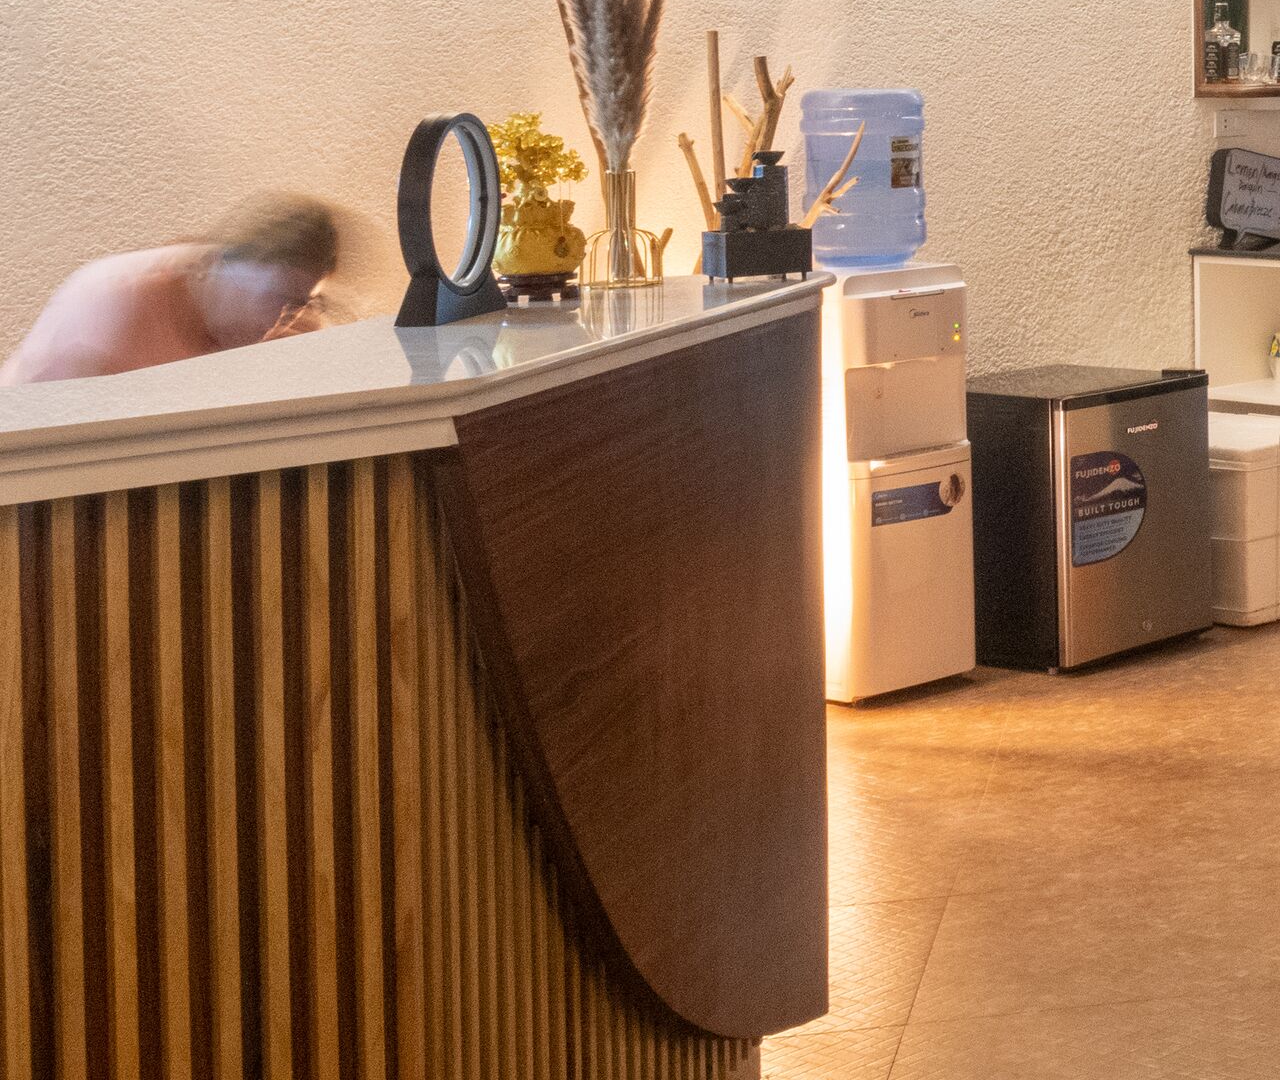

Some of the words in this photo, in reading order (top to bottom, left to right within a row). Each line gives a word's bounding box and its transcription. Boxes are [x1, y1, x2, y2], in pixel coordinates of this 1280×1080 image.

[1127, 422, 1158, 434] FUJIDENZO
[1075, 463, 1121, 479] FUJIDENZO
[1078, 504, 1105, 517] BUILT
[1109, 497, 1140, 511] TOUGH
